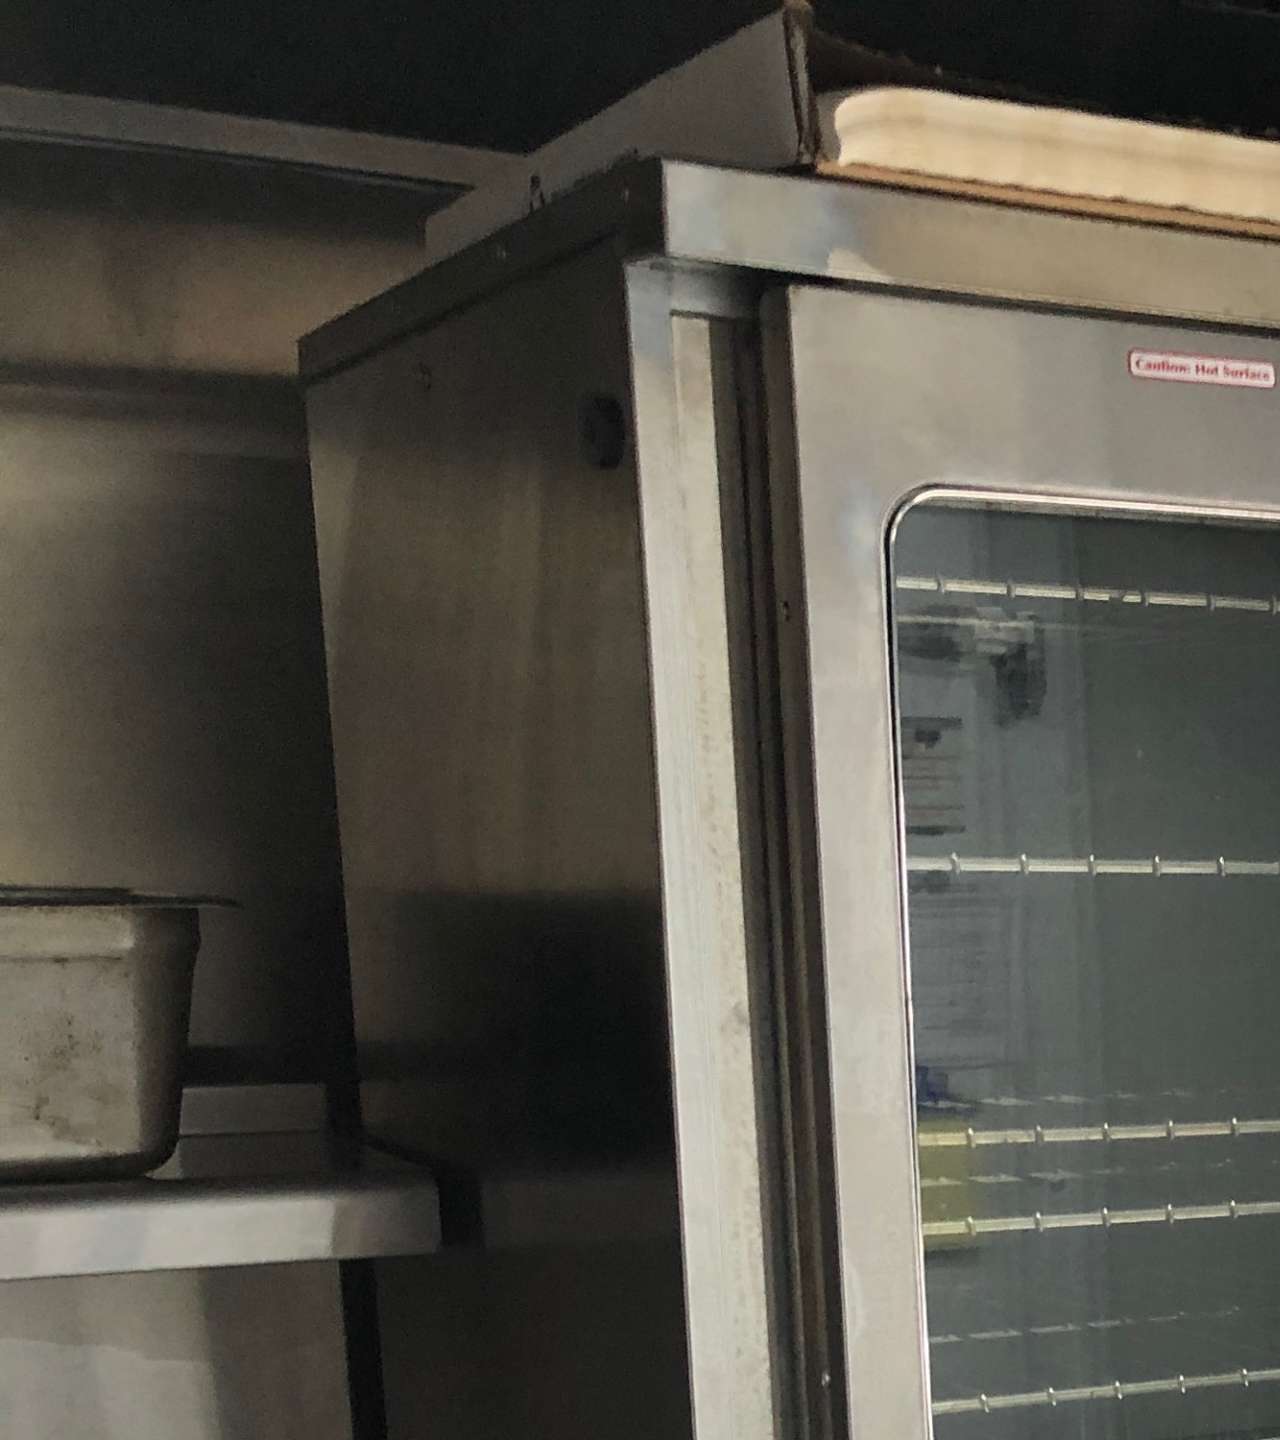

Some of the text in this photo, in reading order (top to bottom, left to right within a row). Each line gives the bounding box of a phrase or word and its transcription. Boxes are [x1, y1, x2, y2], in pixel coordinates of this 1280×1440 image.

[1135, 356, 1270, 381] Caution: Hot Surface
